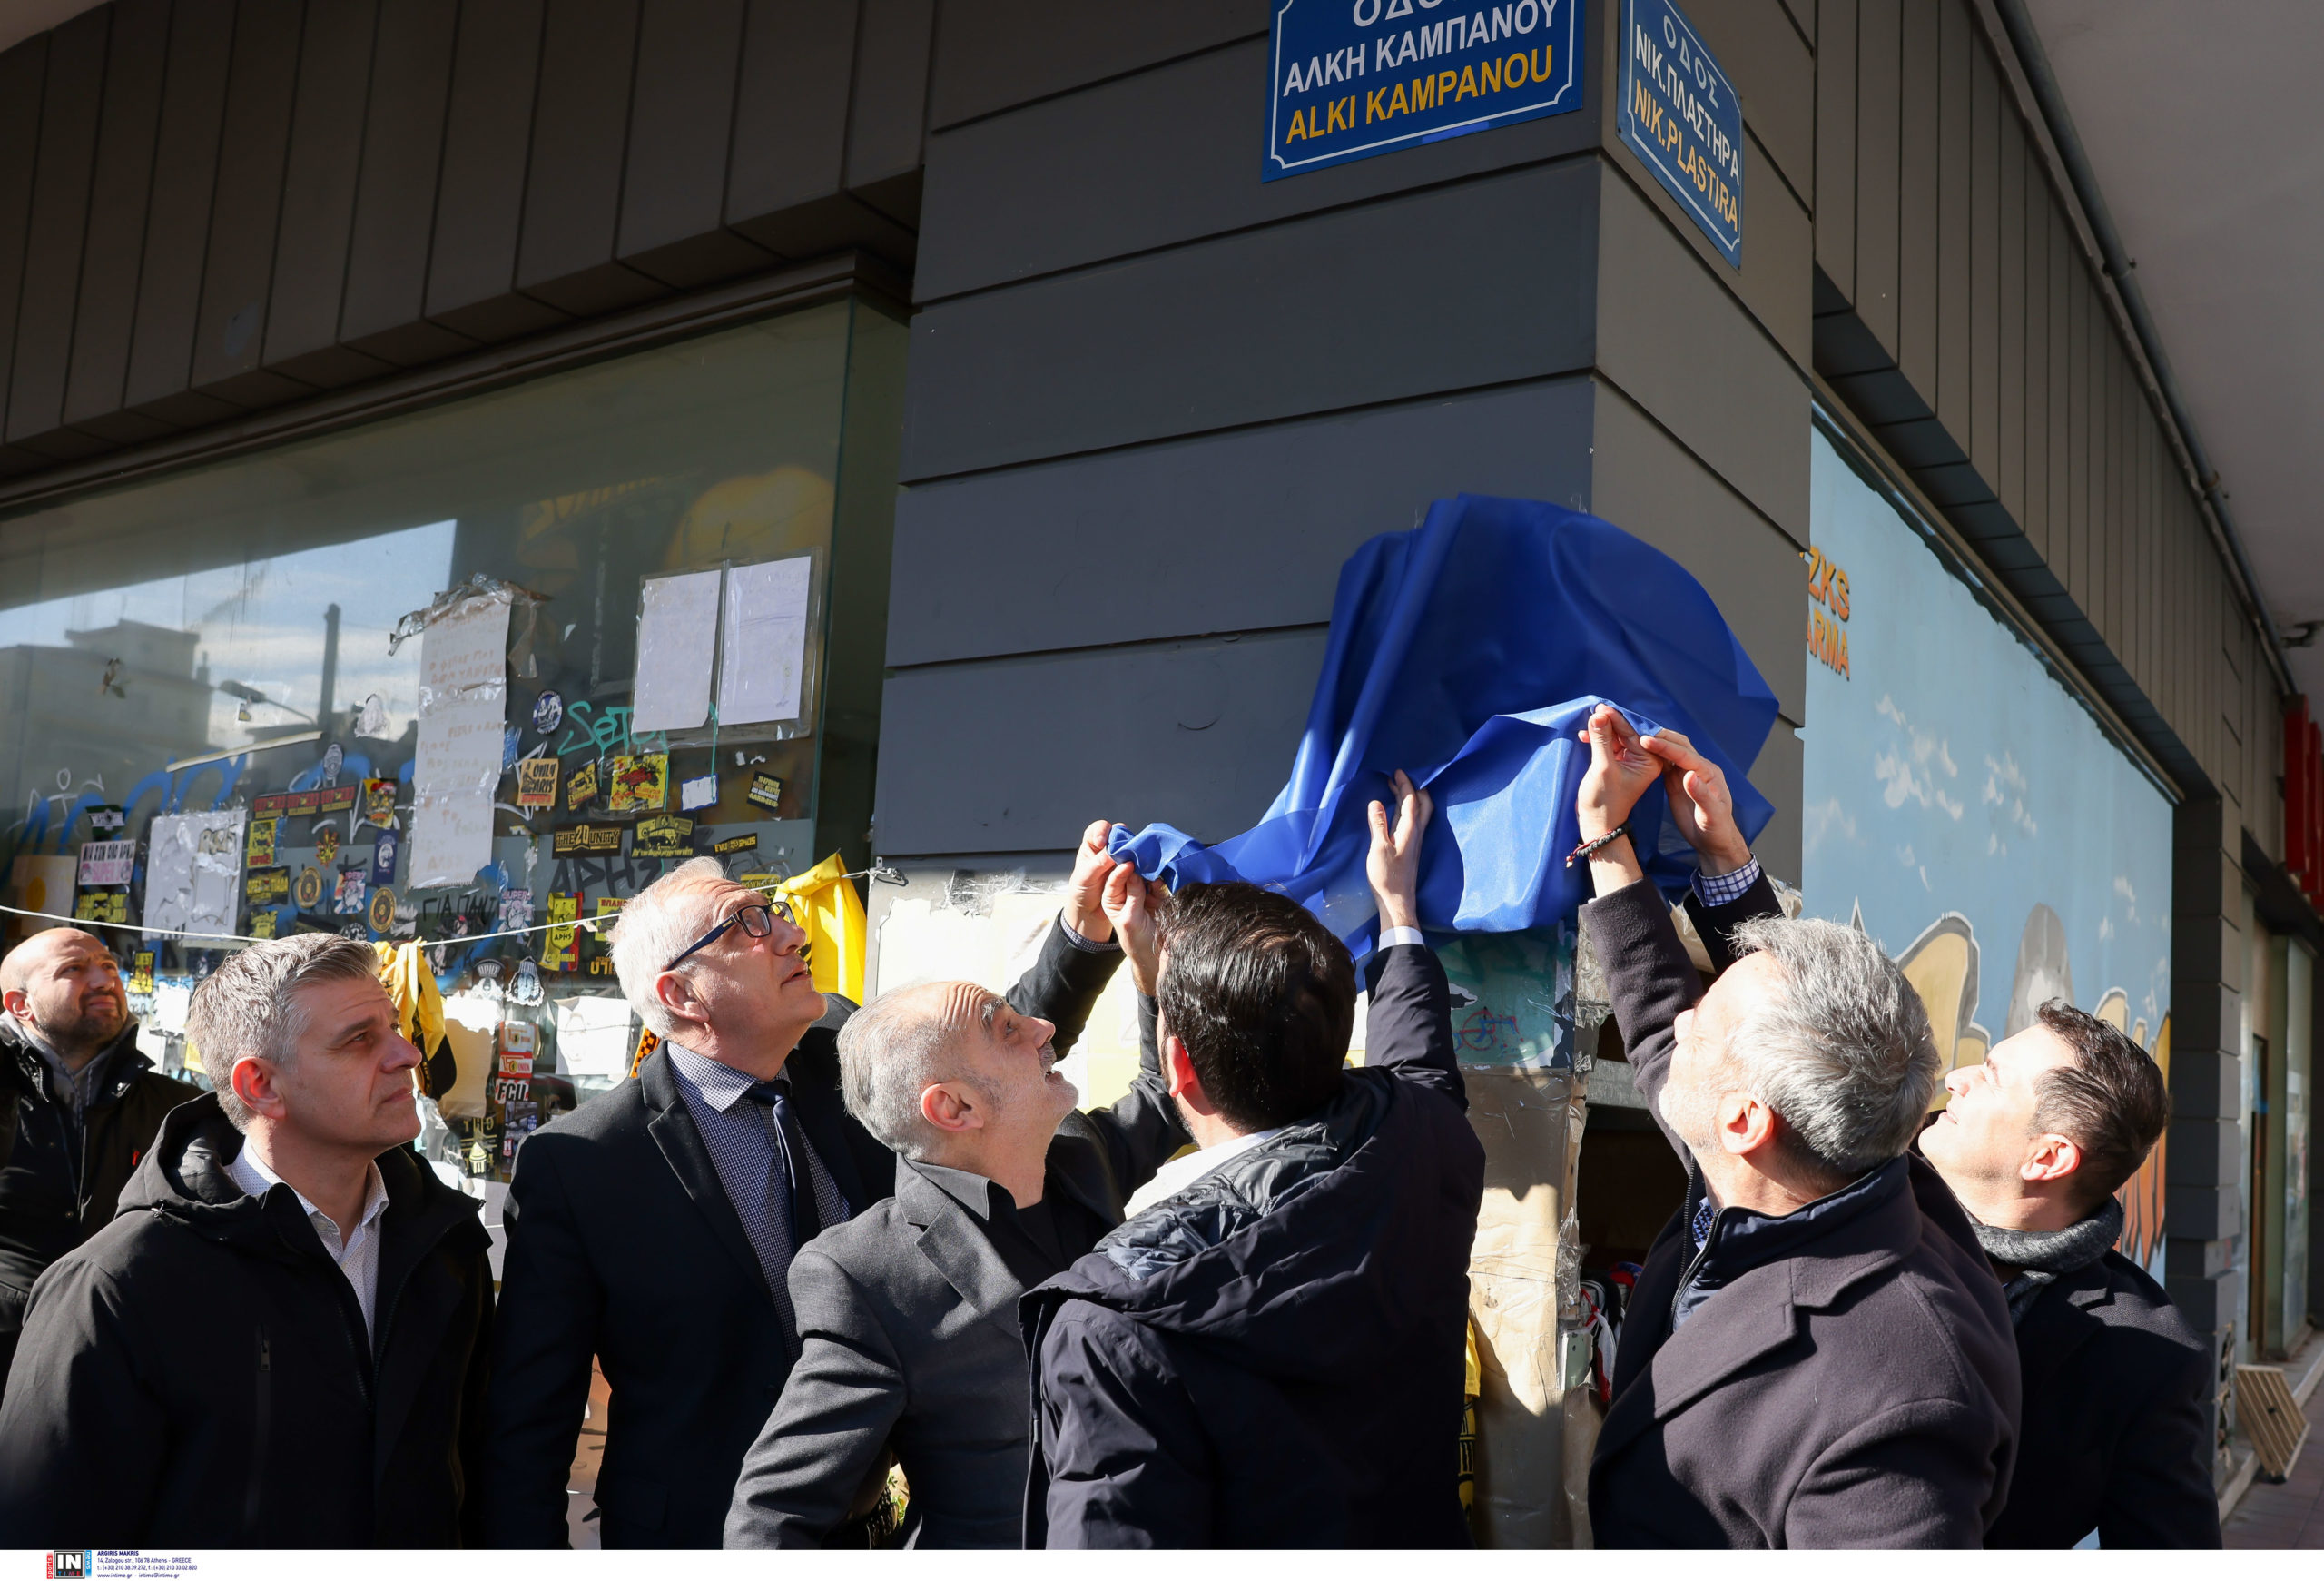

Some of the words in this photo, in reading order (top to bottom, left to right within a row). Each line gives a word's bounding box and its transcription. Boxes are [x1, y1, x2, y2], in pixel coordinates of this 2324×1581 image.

[1283, 42, 1365, 97] ΑΛΚΗ
[1375, 0, 1558, 73] ΚΑΜΠΑΝΟΥ
[1285, 95, 1356, 143] ALKI
[1365, 44, 1554, 125] KAMPANOU
[1663, 15, 1721, 108] ΟΔΟΣ
[1636, 23, 1742, 187] ΝΙΚ.ΠΛΑΣΤΗΡΑ
[1634, 80, 1739, 232] NIK.PLASTIRA
[532, 762, 556, 777] ONLY
[532, 778, 556, 793] ARIS
[556, 833, 576, 846] THE
[576, 824, 590, 845] 20
[591, 830, 619, 845] UNITY
[422, 894, 450, 921] ΓΙΑ
